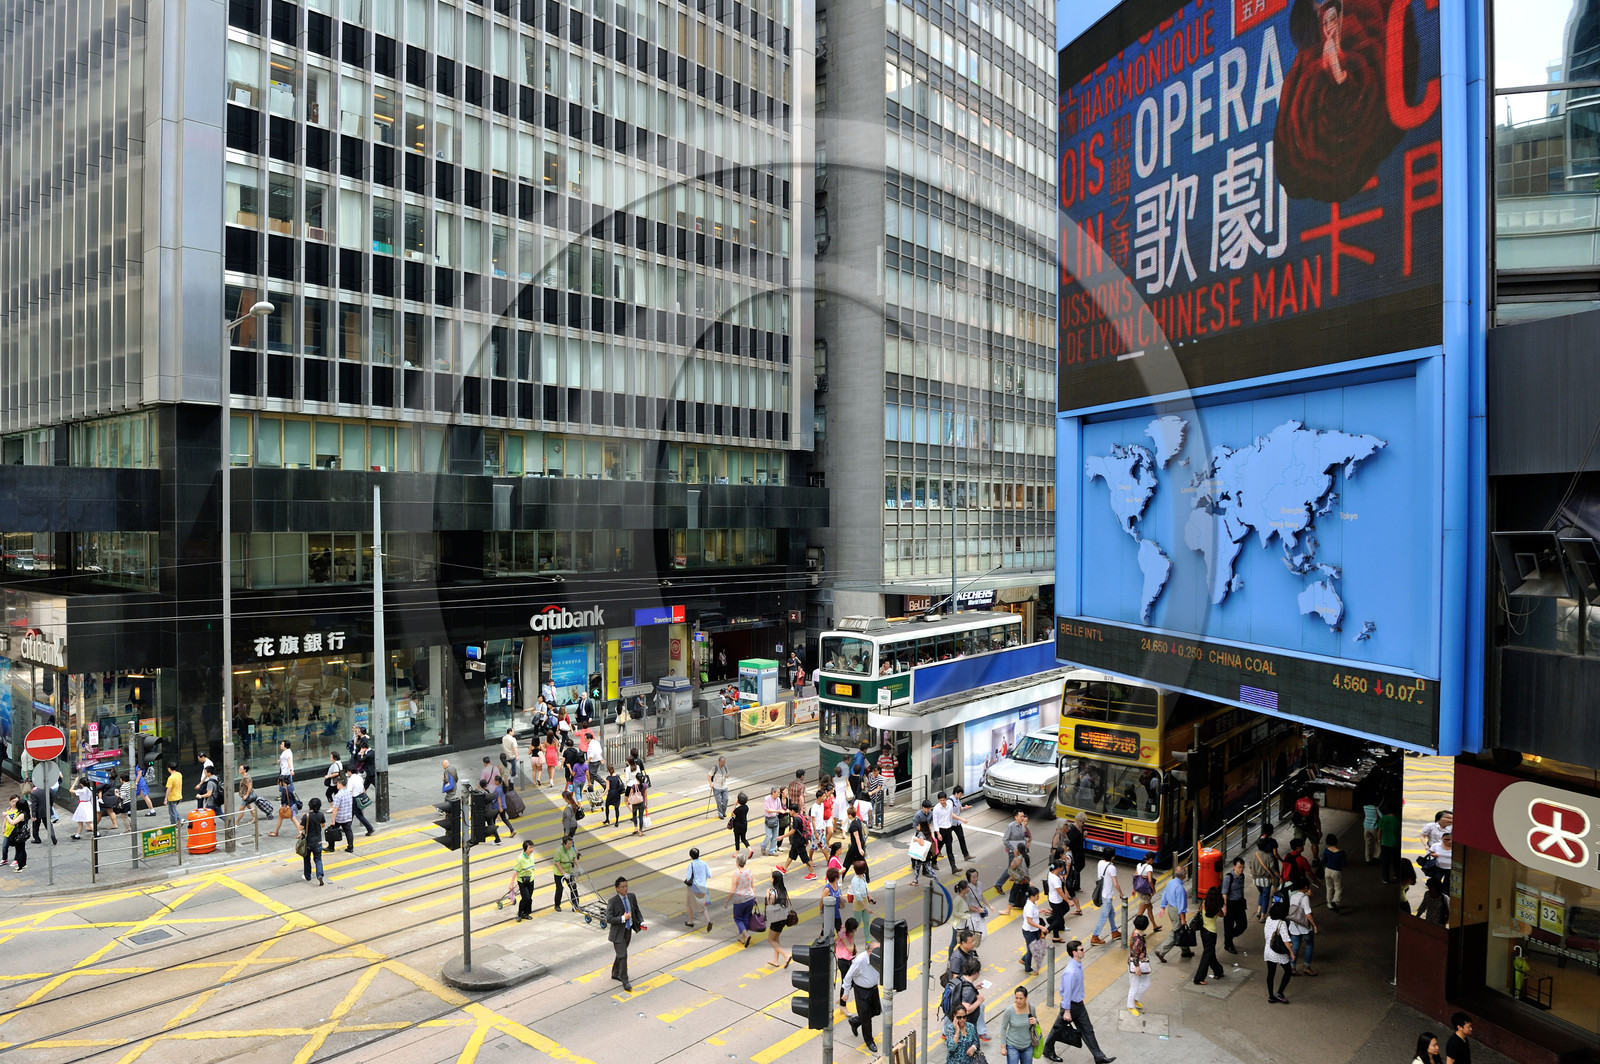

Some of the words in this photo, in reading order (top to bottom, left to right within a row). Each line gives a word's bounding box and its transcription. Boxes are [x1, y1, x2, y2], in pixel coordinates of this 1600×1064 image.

[1080, 9, 1214, 130] HARMONIQUE
[1135, 25, 1284, 179] OPERA
[1062, 132, 1104, 208] OIS
[1134, 140, 1287, 294] 歌劇
[1062, 211, 1103, 286] LIN
[1061, 275, 1132, 329] USSIONS
[1138, 277, 1242, 347] CHINESE
[1253, 254, 1321, 322] MAN
[1067, 328, 1085, 365] DE
[1091, 315, 1133, 360] LYON
[1340, 512, 1358, 522] Tokyo
[530, 605, 604, 631] citibank
[956, 590, 993, 601] KECHERS
[21, 631, 65, 667] citibank
[253, 631, 346, 657] 花旗銀行
[1060, 622, 1082, 638] BELLE
[1141, 638, 1168, 654] 24.650
[1178, 645, 1202, 661] 0.250
[1209, 650, 1242, 669] CHINA
[1245, 656, 1277, 676] COAL
[1332, 673, 1368, 693] 4.560
[1113, 741, 1136, 754] 780
